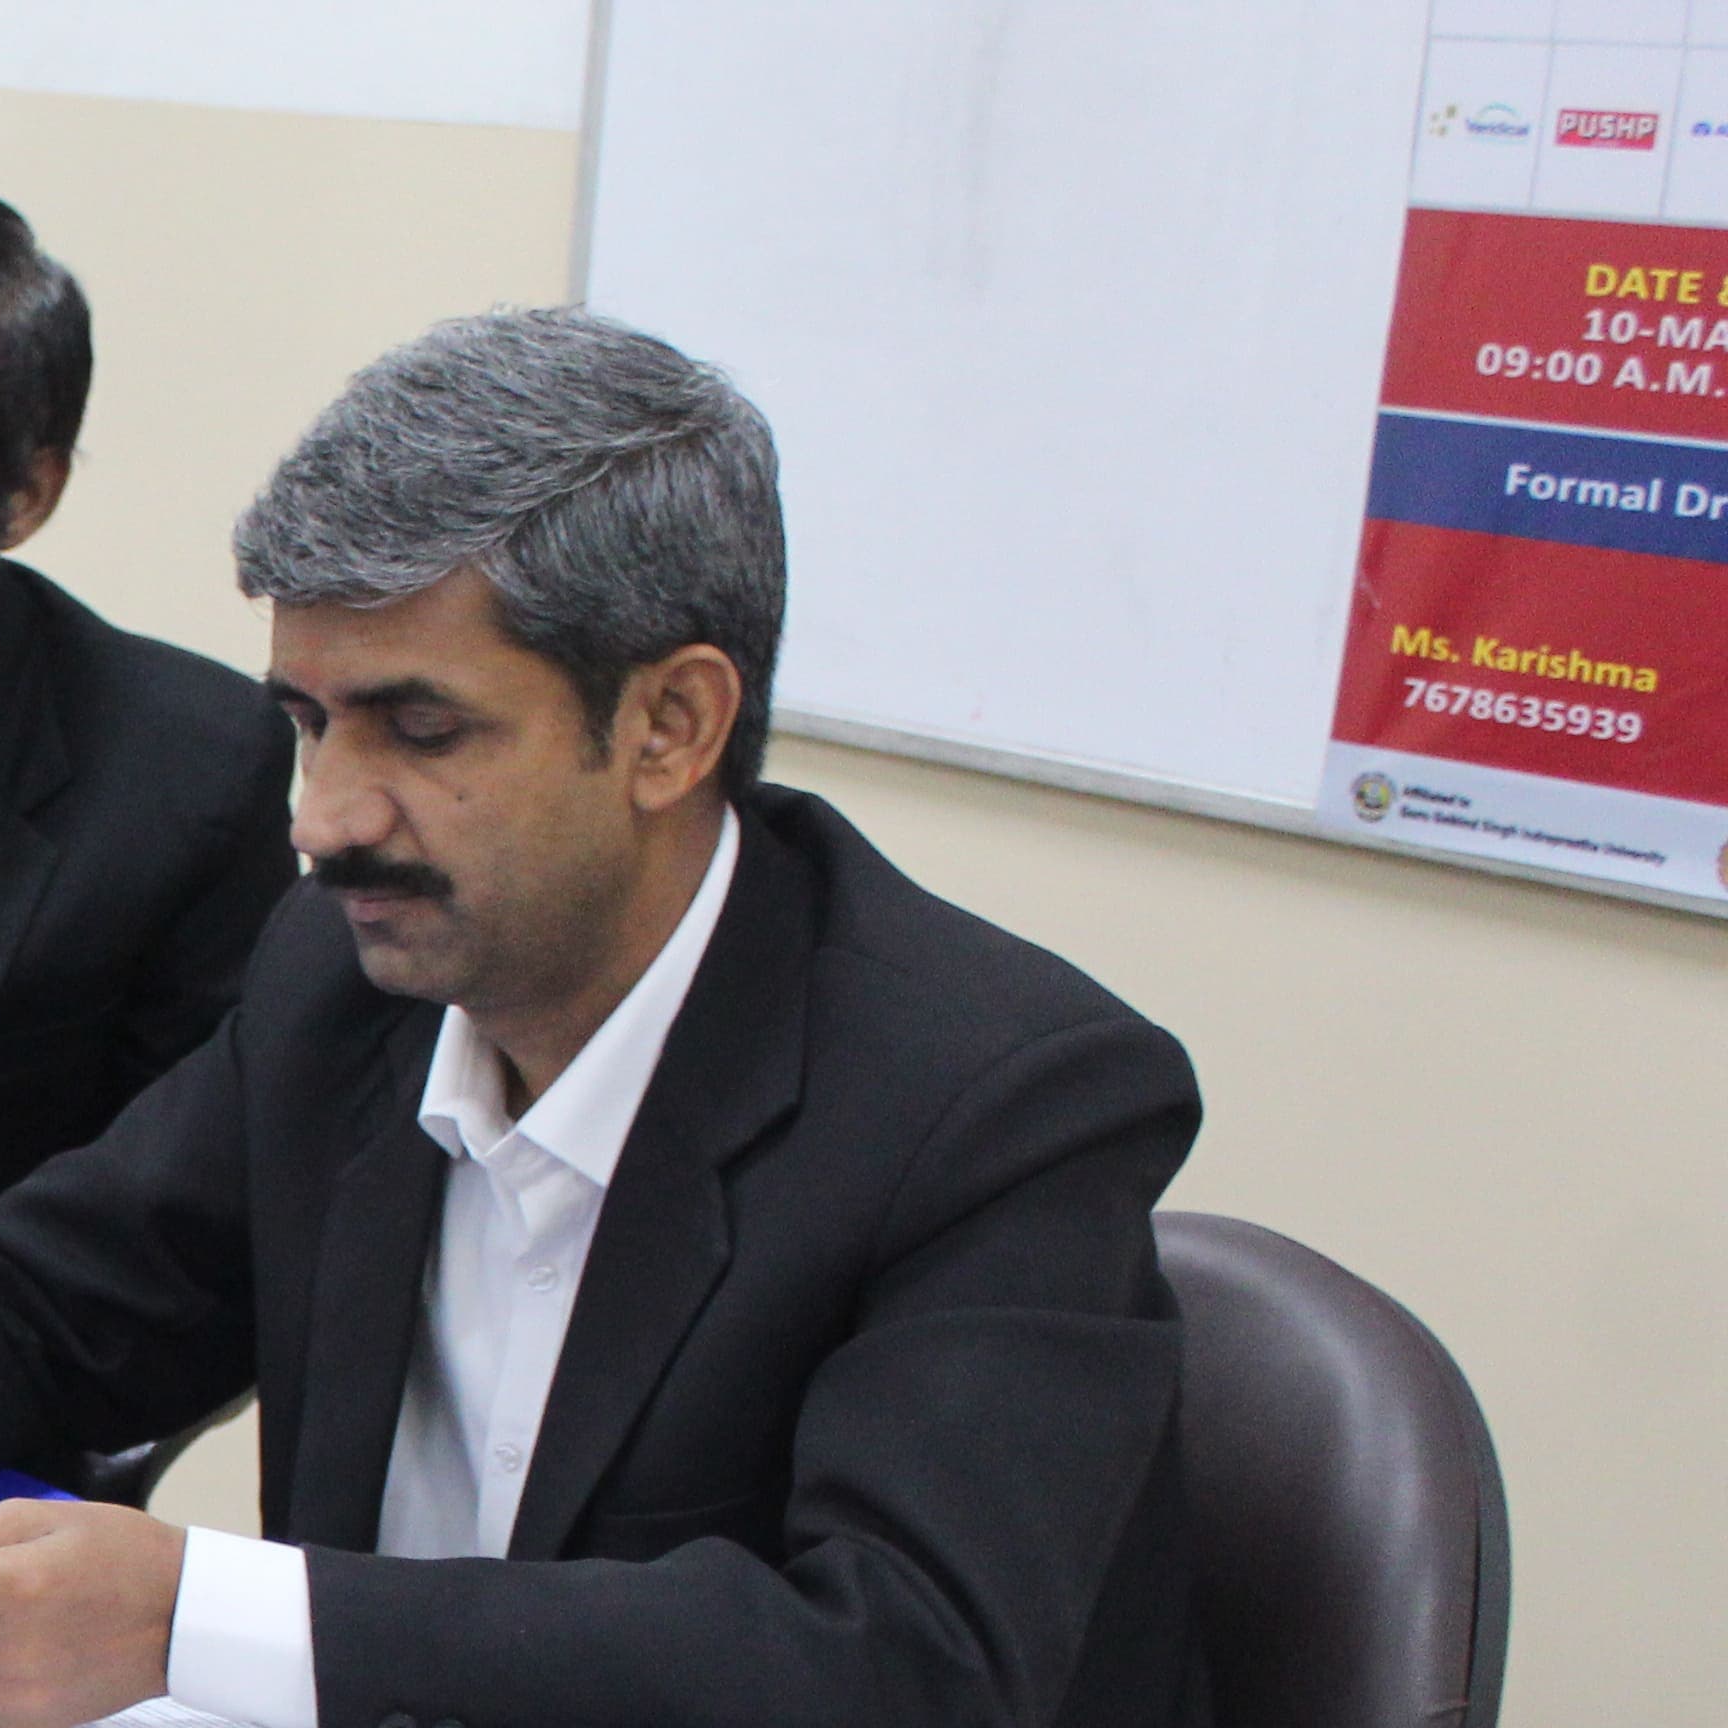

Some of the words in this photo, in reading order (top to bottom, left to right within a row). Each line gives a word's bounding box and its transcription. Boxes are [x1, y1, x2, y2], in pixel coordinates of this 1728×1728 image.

[1560, 112, 1656, 139] PUSHP
[1585, 264, 1702, 304] DATE
[1476, 343, 1603, 386] 09:00
[1613, 357, 1725, 398] A.M.
[1506, 463, 1662, 512] Formal
[1391, 625, 1460, 663] Ms.
[1472, 635, 1658, 693] Karishma
[1403, 677, 1643, 743] 7678635939
